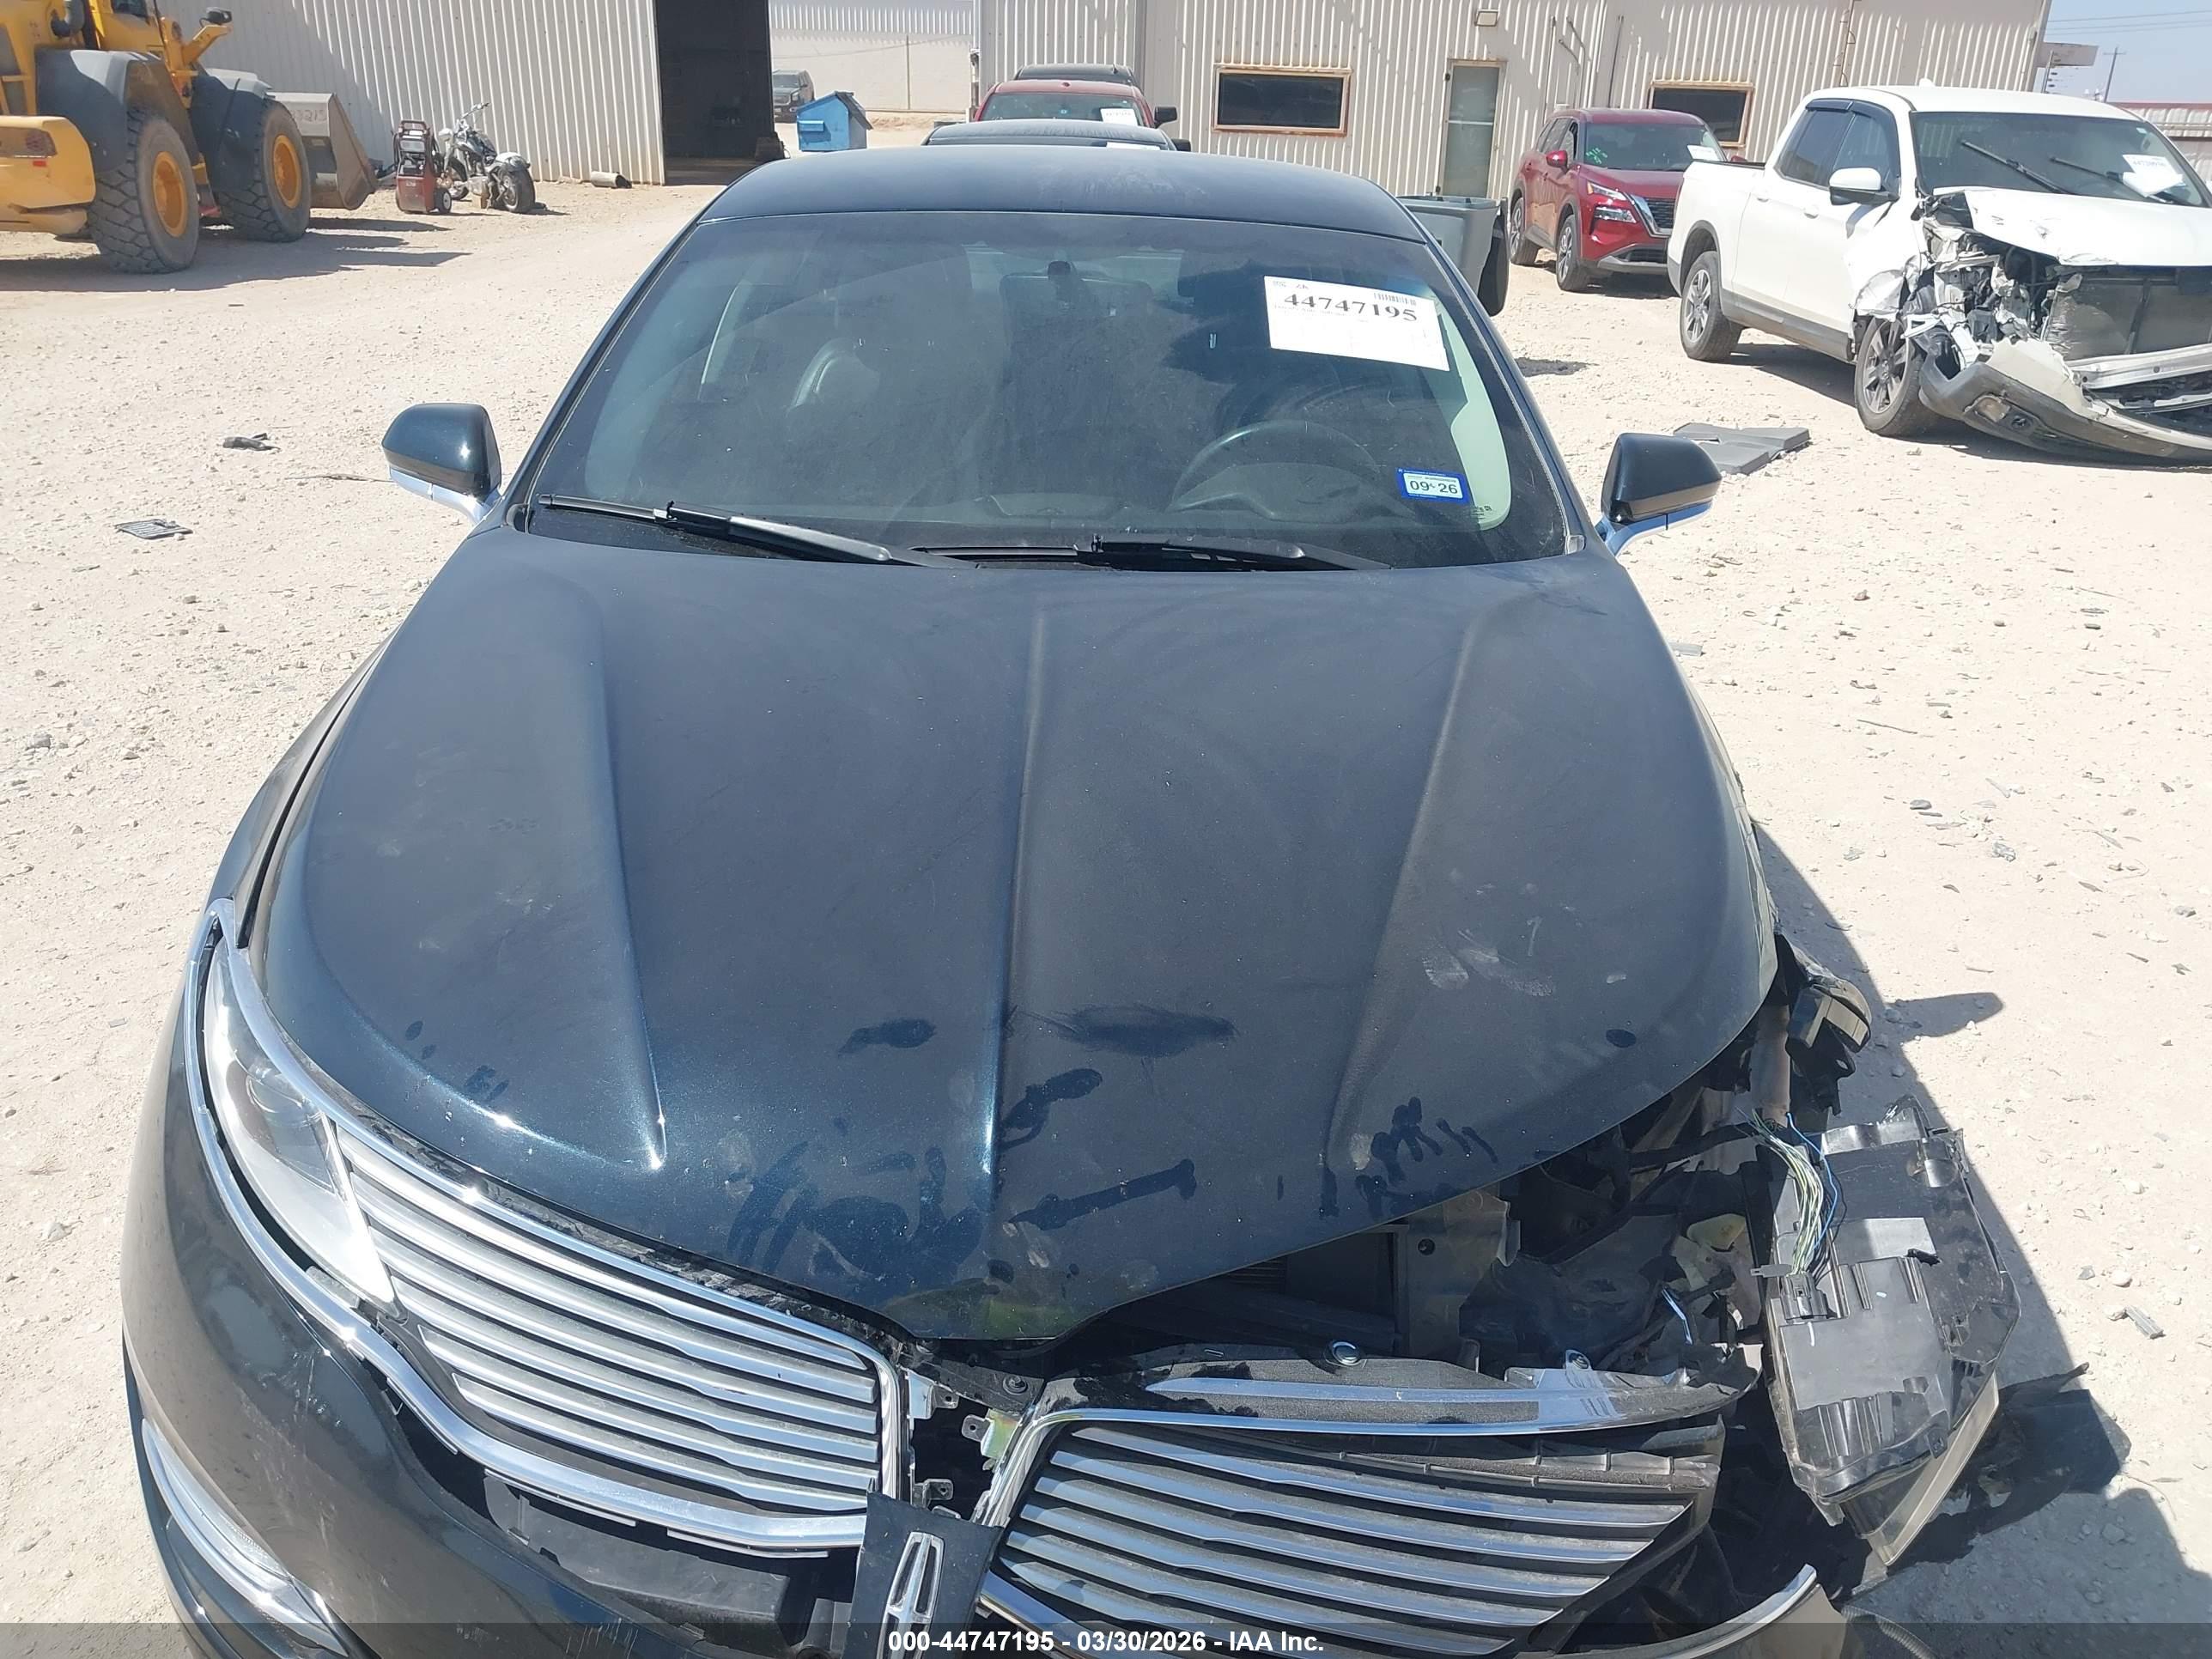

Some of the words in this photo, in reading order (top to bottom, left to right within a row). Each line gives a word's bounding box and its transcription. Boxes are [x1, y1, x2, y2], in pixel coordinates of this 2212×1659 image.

[1284, 293, 1418, 322] 44747195
[1409, 480, 1430, 491] 09
[1437, 483, 1458, 494] 26
